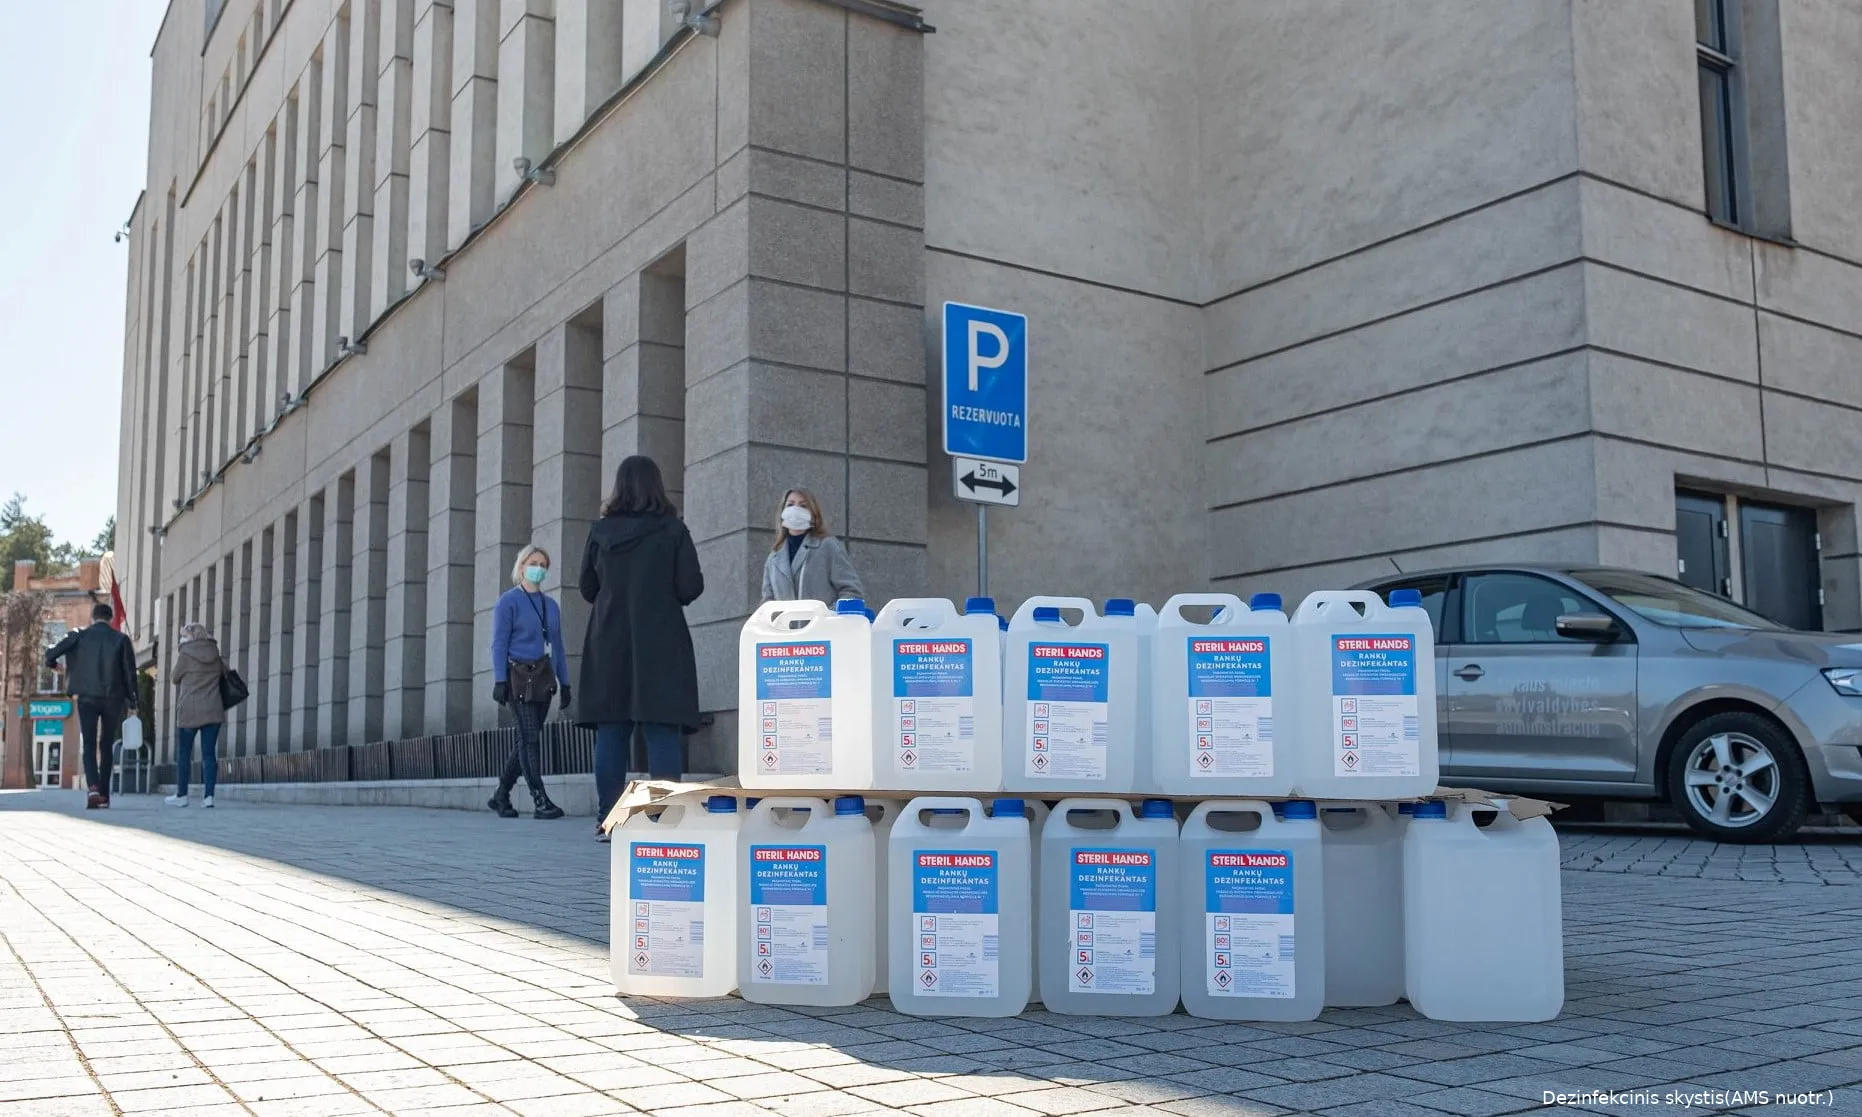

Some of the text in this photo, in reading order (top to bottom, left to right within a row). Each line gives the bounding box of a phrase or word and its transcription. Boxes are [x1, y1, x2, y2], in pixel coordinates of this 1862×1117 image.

[968, 319, 1010, 391] P
[952, 404, 1021, 429] REZERVUOTA
[979, 463, 998, 479] 5m
[900, 644, 966, 654] STERIL HANDS
[1195, 643, 1263, 651] STERIL HANDS
[1339, 640, 1409, 649] STERIL HANDS
[762, 646, 825, 656] STERIL HANDS
[1035, 648, 1102, 657] STERIL HANDS
[637, 848, 698, 857] STERIL HANDS
[756, 851, 819, 860] STERIL HANDS
[920, 857, 990, 866] STERIL HANDS
[1078, 854, 1148, 864] STERIL HANDS
[1213, 856, 1285, 866] STERIL HANDS
[637, 867, 696, 875] DEZINFEKANTAS
